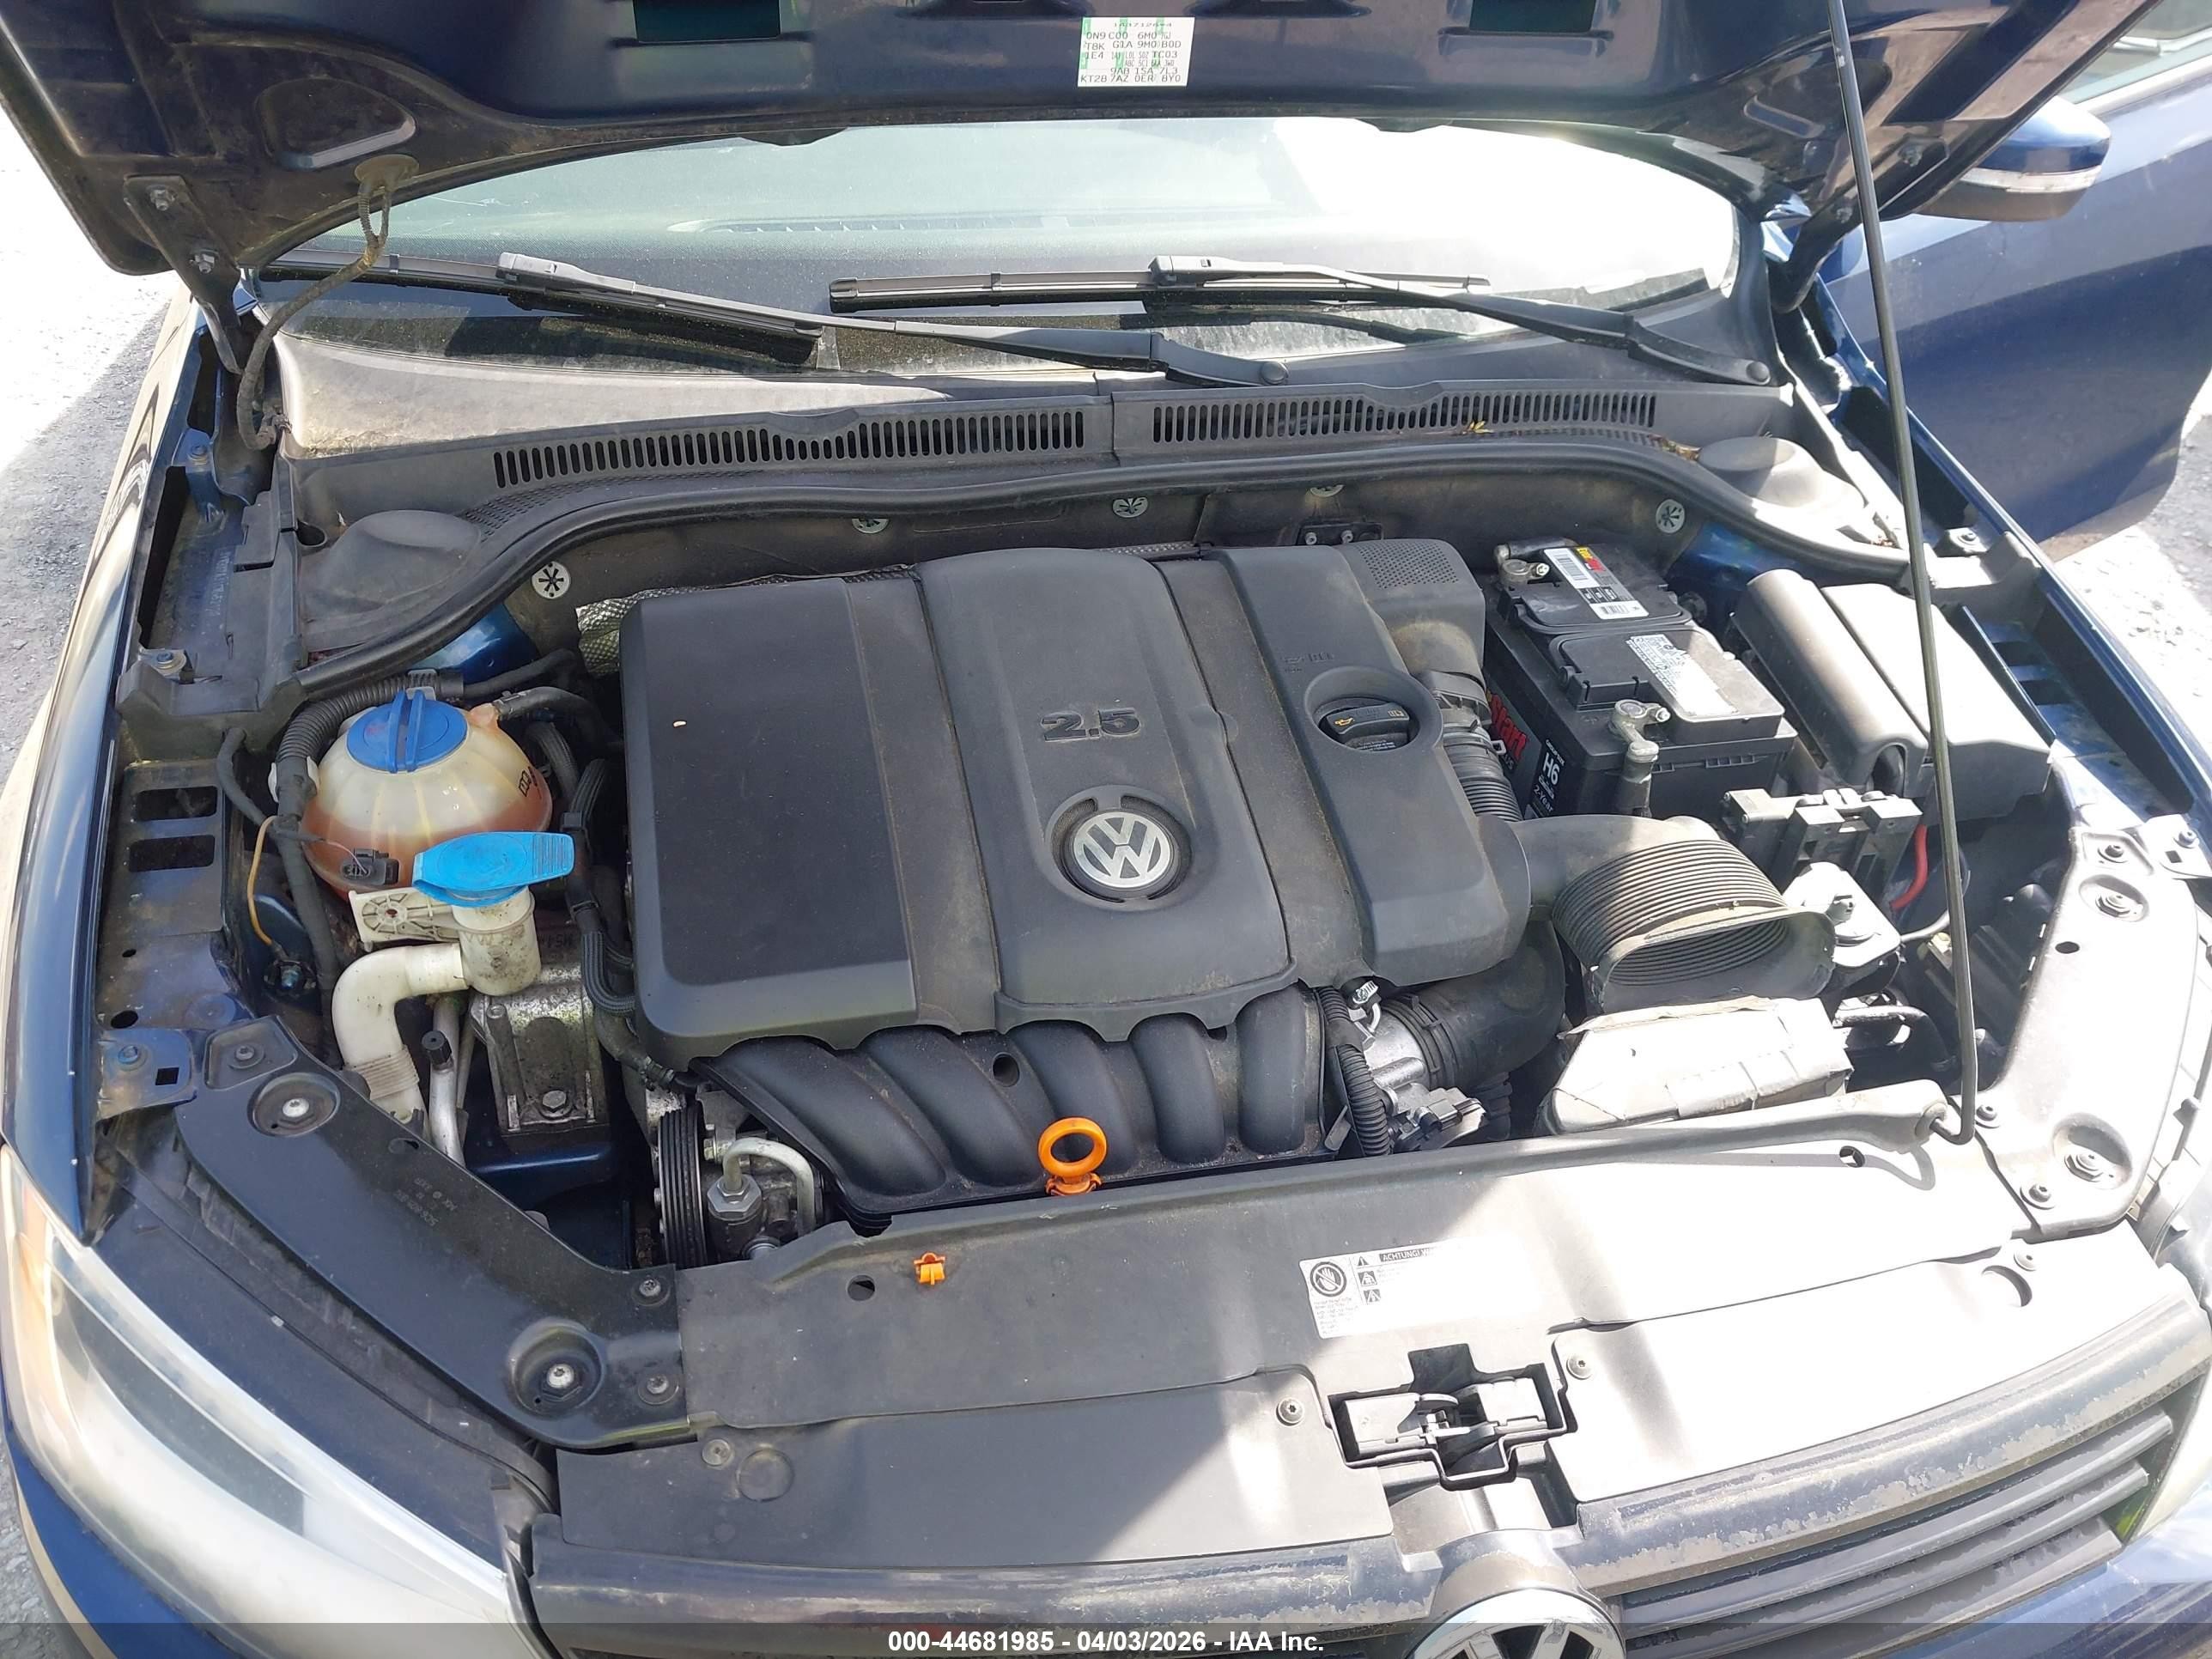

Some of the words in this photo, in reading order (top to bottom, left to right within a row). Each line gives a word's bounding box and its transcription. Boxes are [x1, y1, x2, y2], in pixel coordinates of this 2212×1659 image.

[1040, 707, 1142, 744] 2.5
[1542, 751, 1561, 786] H6
[1533, 784, 1553, 812] 2-Year
